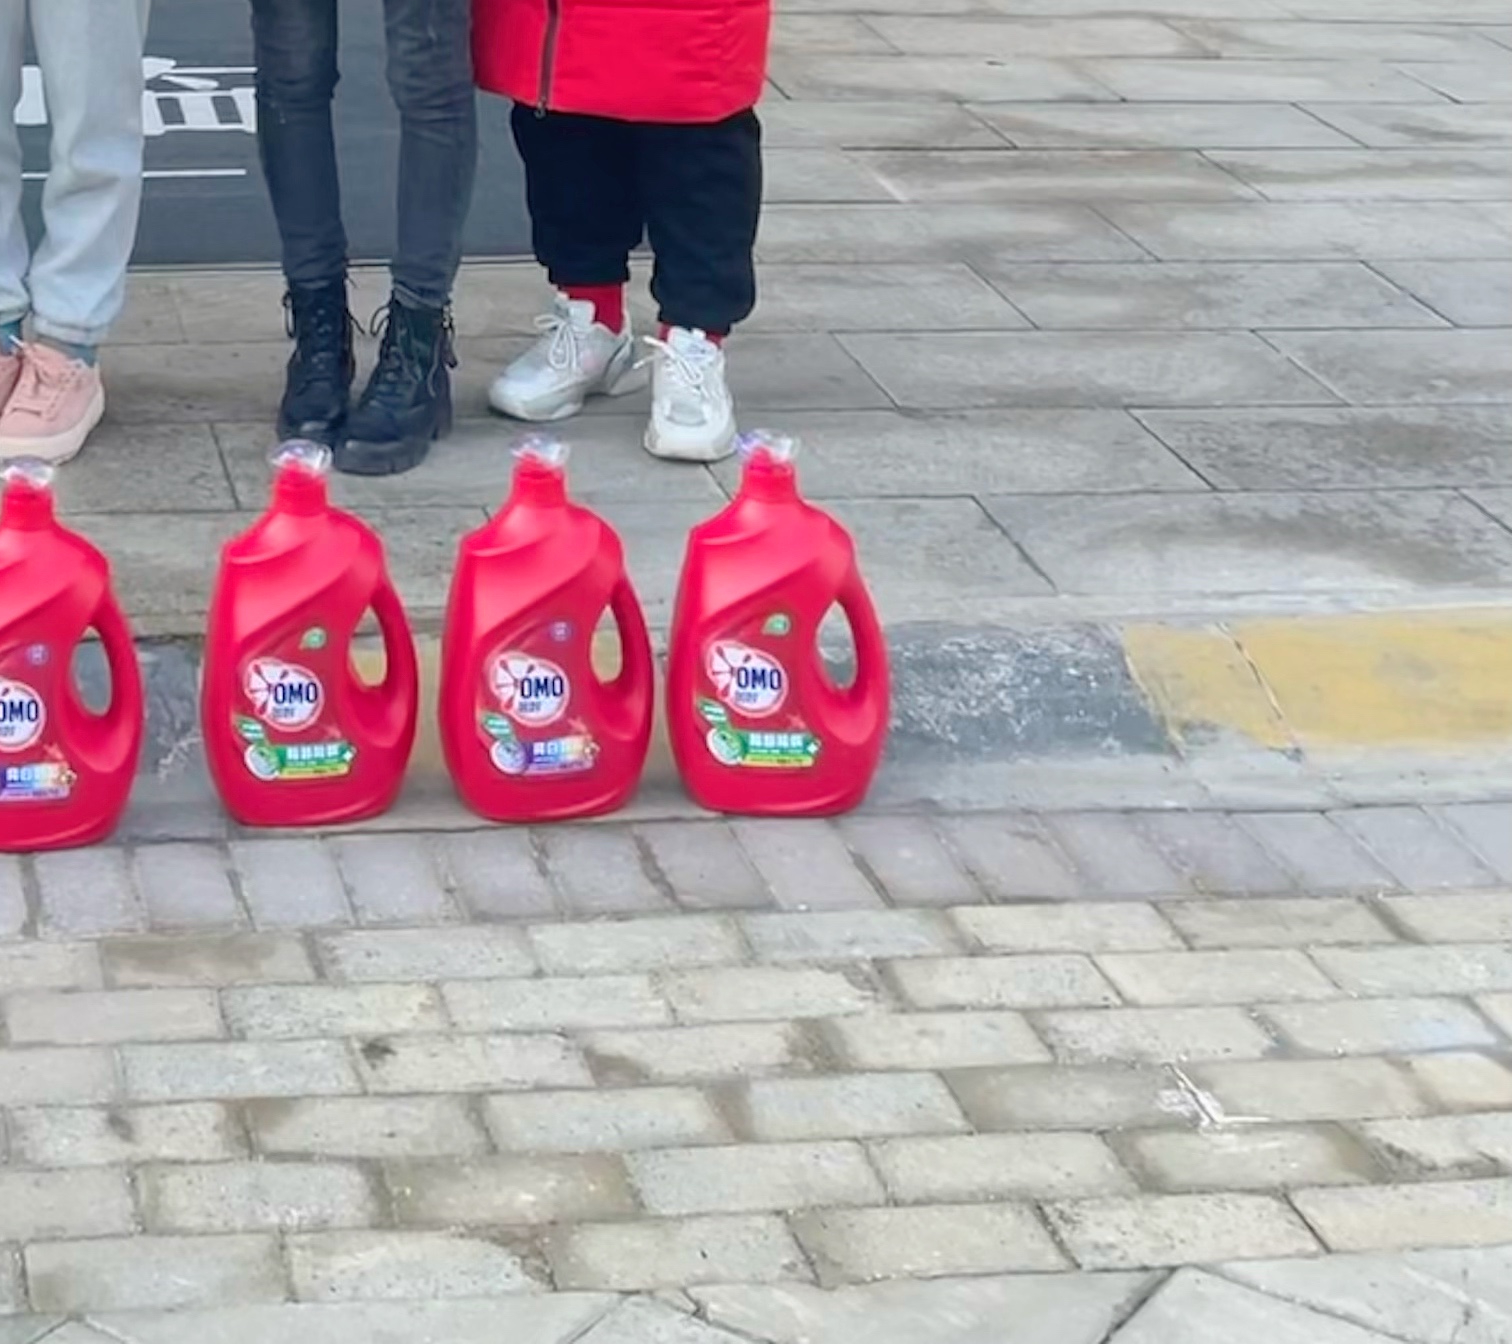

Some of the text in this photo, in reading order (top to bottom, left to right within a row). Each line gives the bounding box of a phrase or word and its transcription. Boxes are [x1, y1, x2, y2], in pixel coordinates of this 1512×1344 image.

[520, 675, 564, 699] OMO
[737, 667, 782, 690] OMO
[273, 682, 318, 705] OMO
